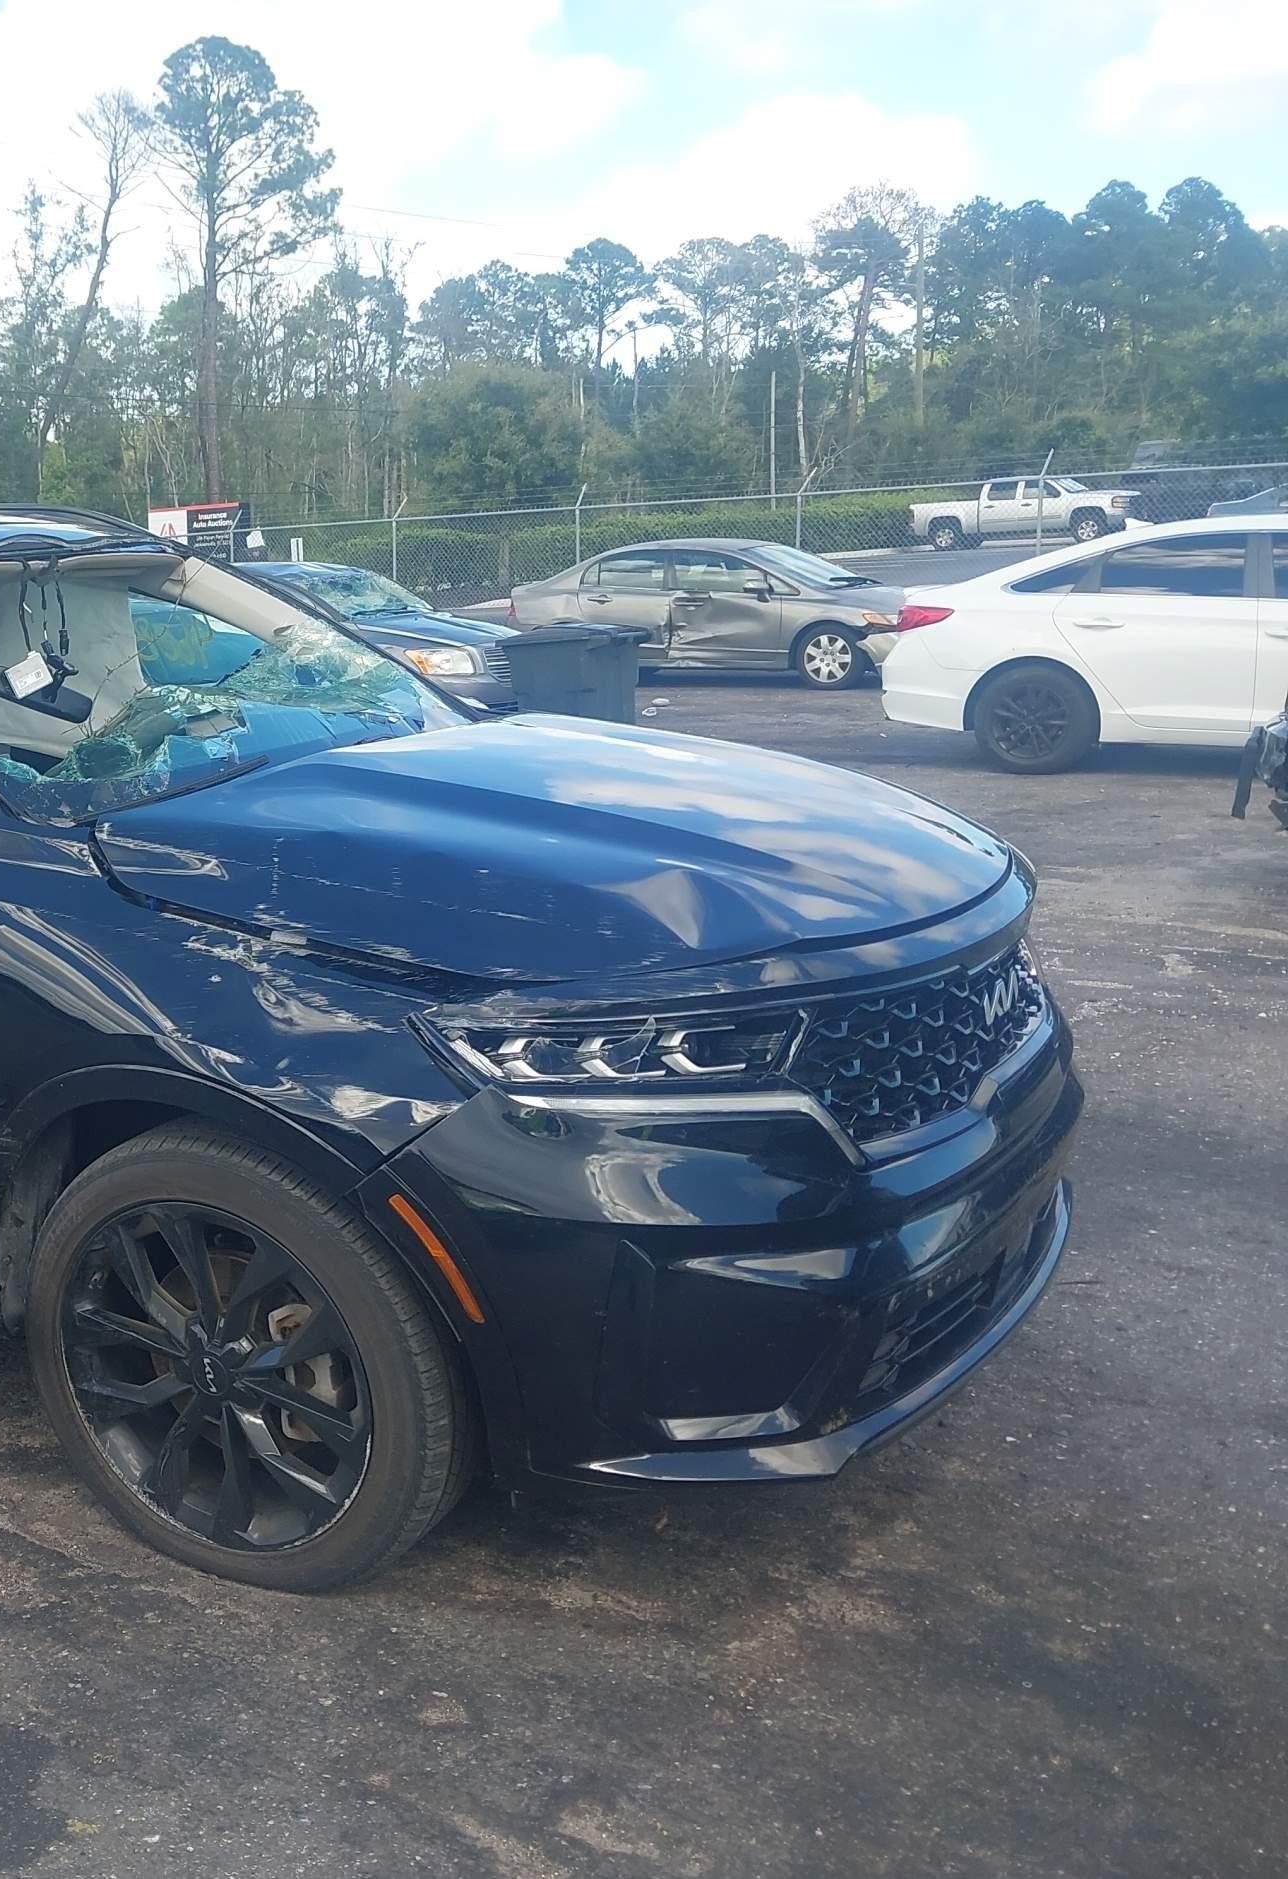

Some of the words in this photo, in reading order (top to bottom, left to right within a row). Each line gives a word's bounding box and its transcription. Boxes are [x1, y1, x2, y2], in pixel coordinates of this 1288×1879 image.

[198, 512, 227, 520] Insurance
[192, 521, 207, 529] Auto
[208, 518, 233, 528] Auctions
